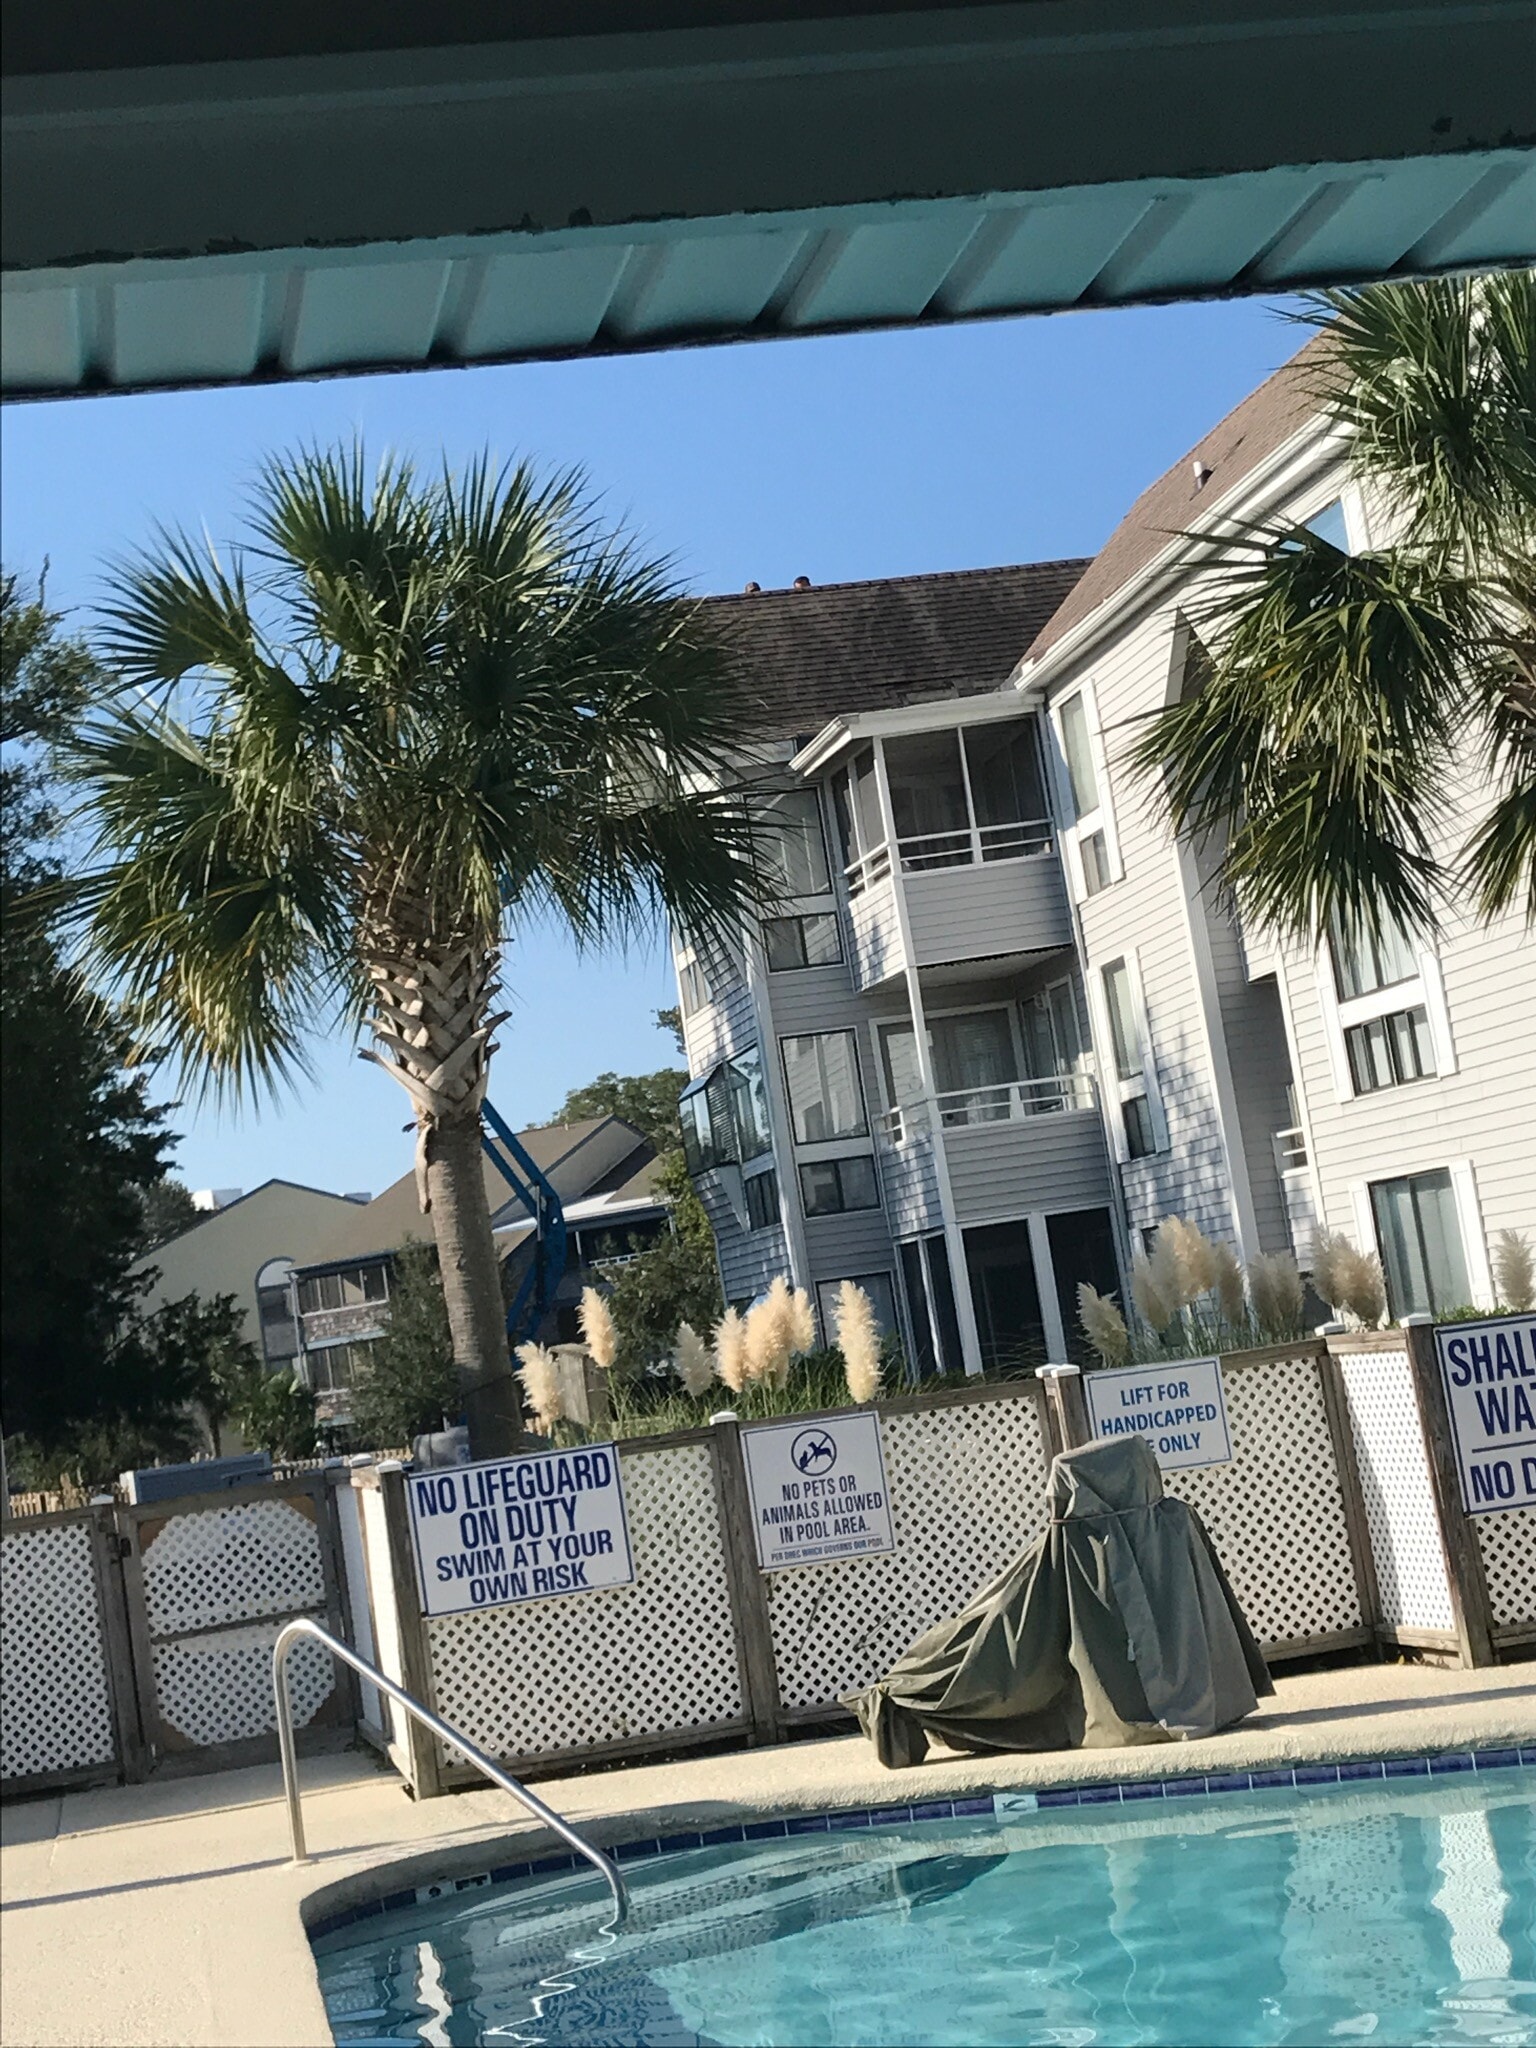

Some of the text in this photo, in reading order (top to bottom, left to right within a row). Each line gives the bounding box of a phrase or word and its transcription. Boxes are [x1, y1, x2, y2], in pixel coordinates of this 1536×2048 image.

[1448, 1328, 1536, 1387] SHAL
[1121, 1381, 1190, 1406] LIFT FOR
[1475, 1382, 1536, 1436] WA
[1101, 1404, 1217, 1436] HANDICAPPED
[1159, 1432, 1201, 1454] ONLY
[416, 1452, 611, 1517] NO LIFEGUARD
[782, 1475, 857, 1501] NO PETS OR
[1470, 1460, 1516, 1503] NO
[459, 1495, 577, 1550] ON DUTY
[762, 1492, 883, 1526] ANIMALS ALLOWED
[780, 1515, 871, 1544] IN POOL AREA.
[436, 1529, 613, 1582] SWIM AT YOUR
[469, 1562, 588, 1604] OWN RISK
